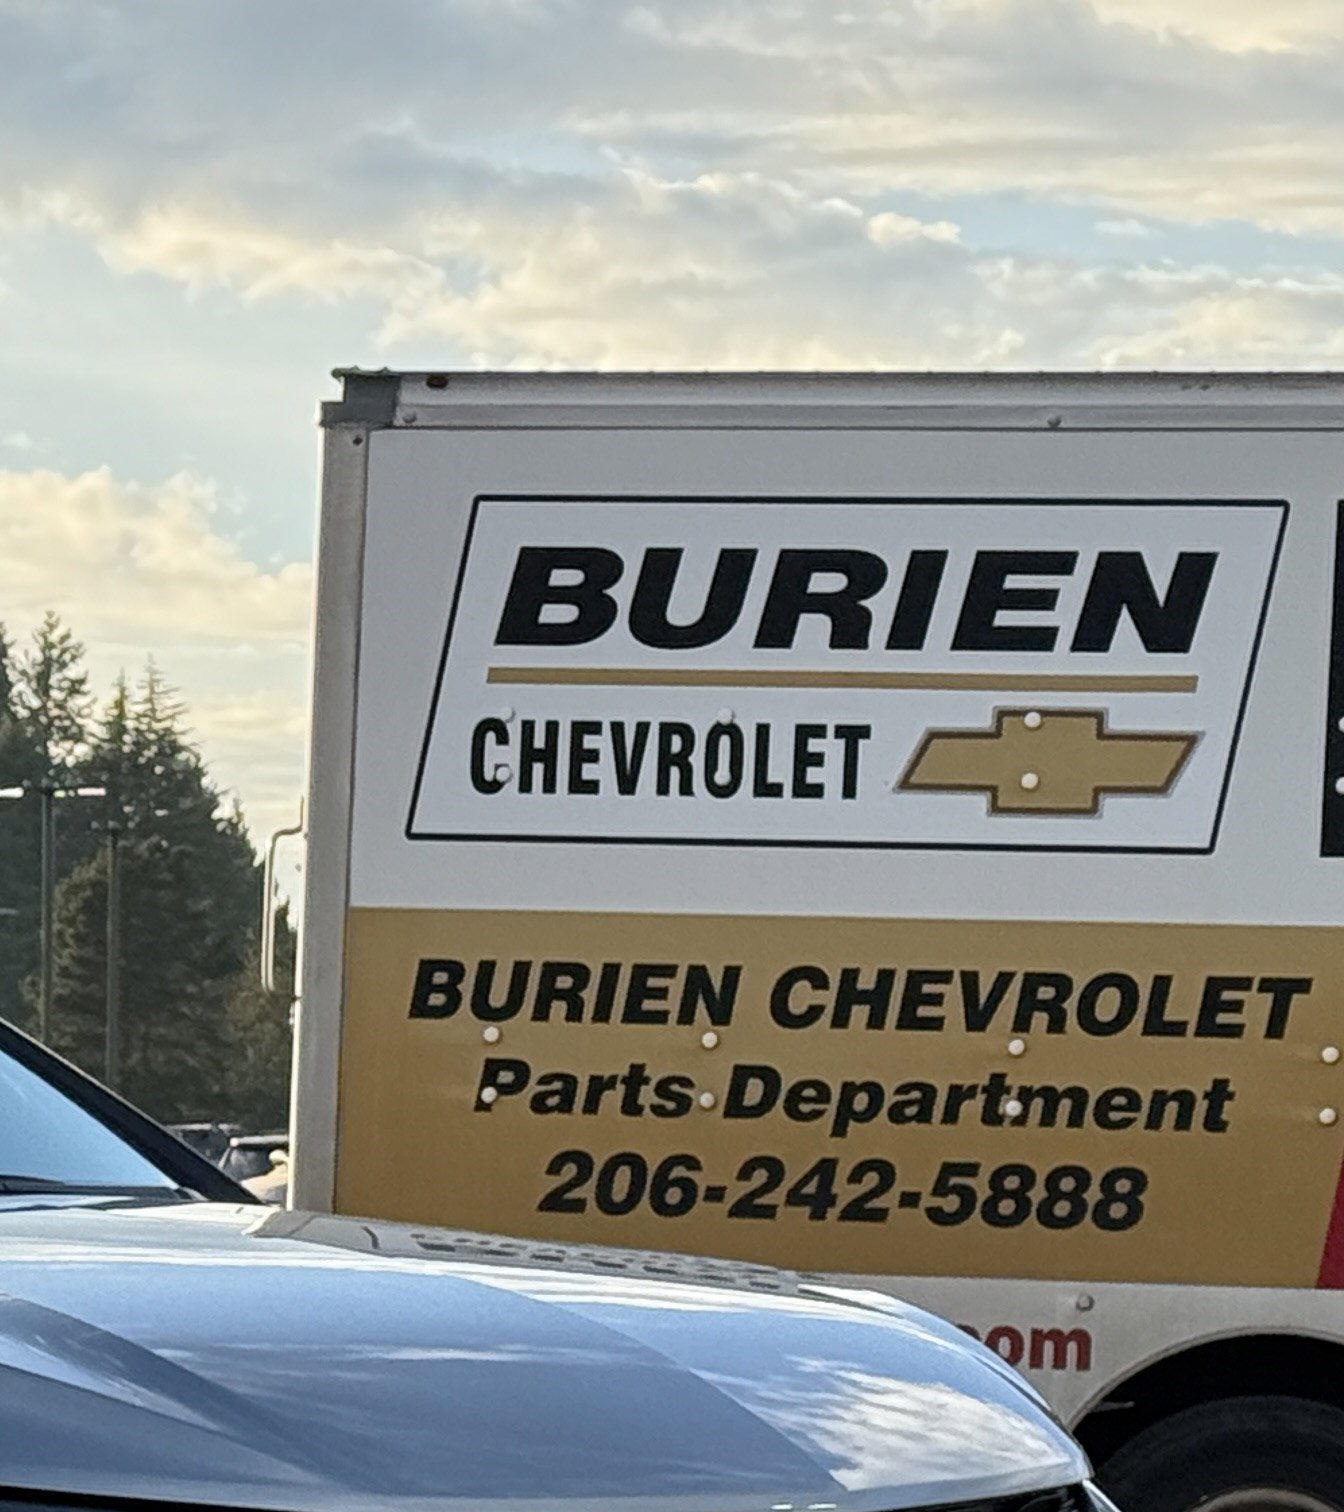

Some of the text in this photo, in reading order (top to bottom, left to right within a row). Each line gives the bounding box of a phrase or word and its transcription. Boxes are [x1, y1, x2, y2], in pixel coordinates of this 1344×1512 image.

[494, 546, 1218, 654] BURIEN
[470, 718, 871, 800] CHEVROLET
[408, 958, 1312, 1040] BURIEN CHEVROLET
[473, 1057, 1236, 1137] Parts Department
[538, 1149, 1149, 1232] 206-242-5888
[955, 1324, 1093, 1371] om
